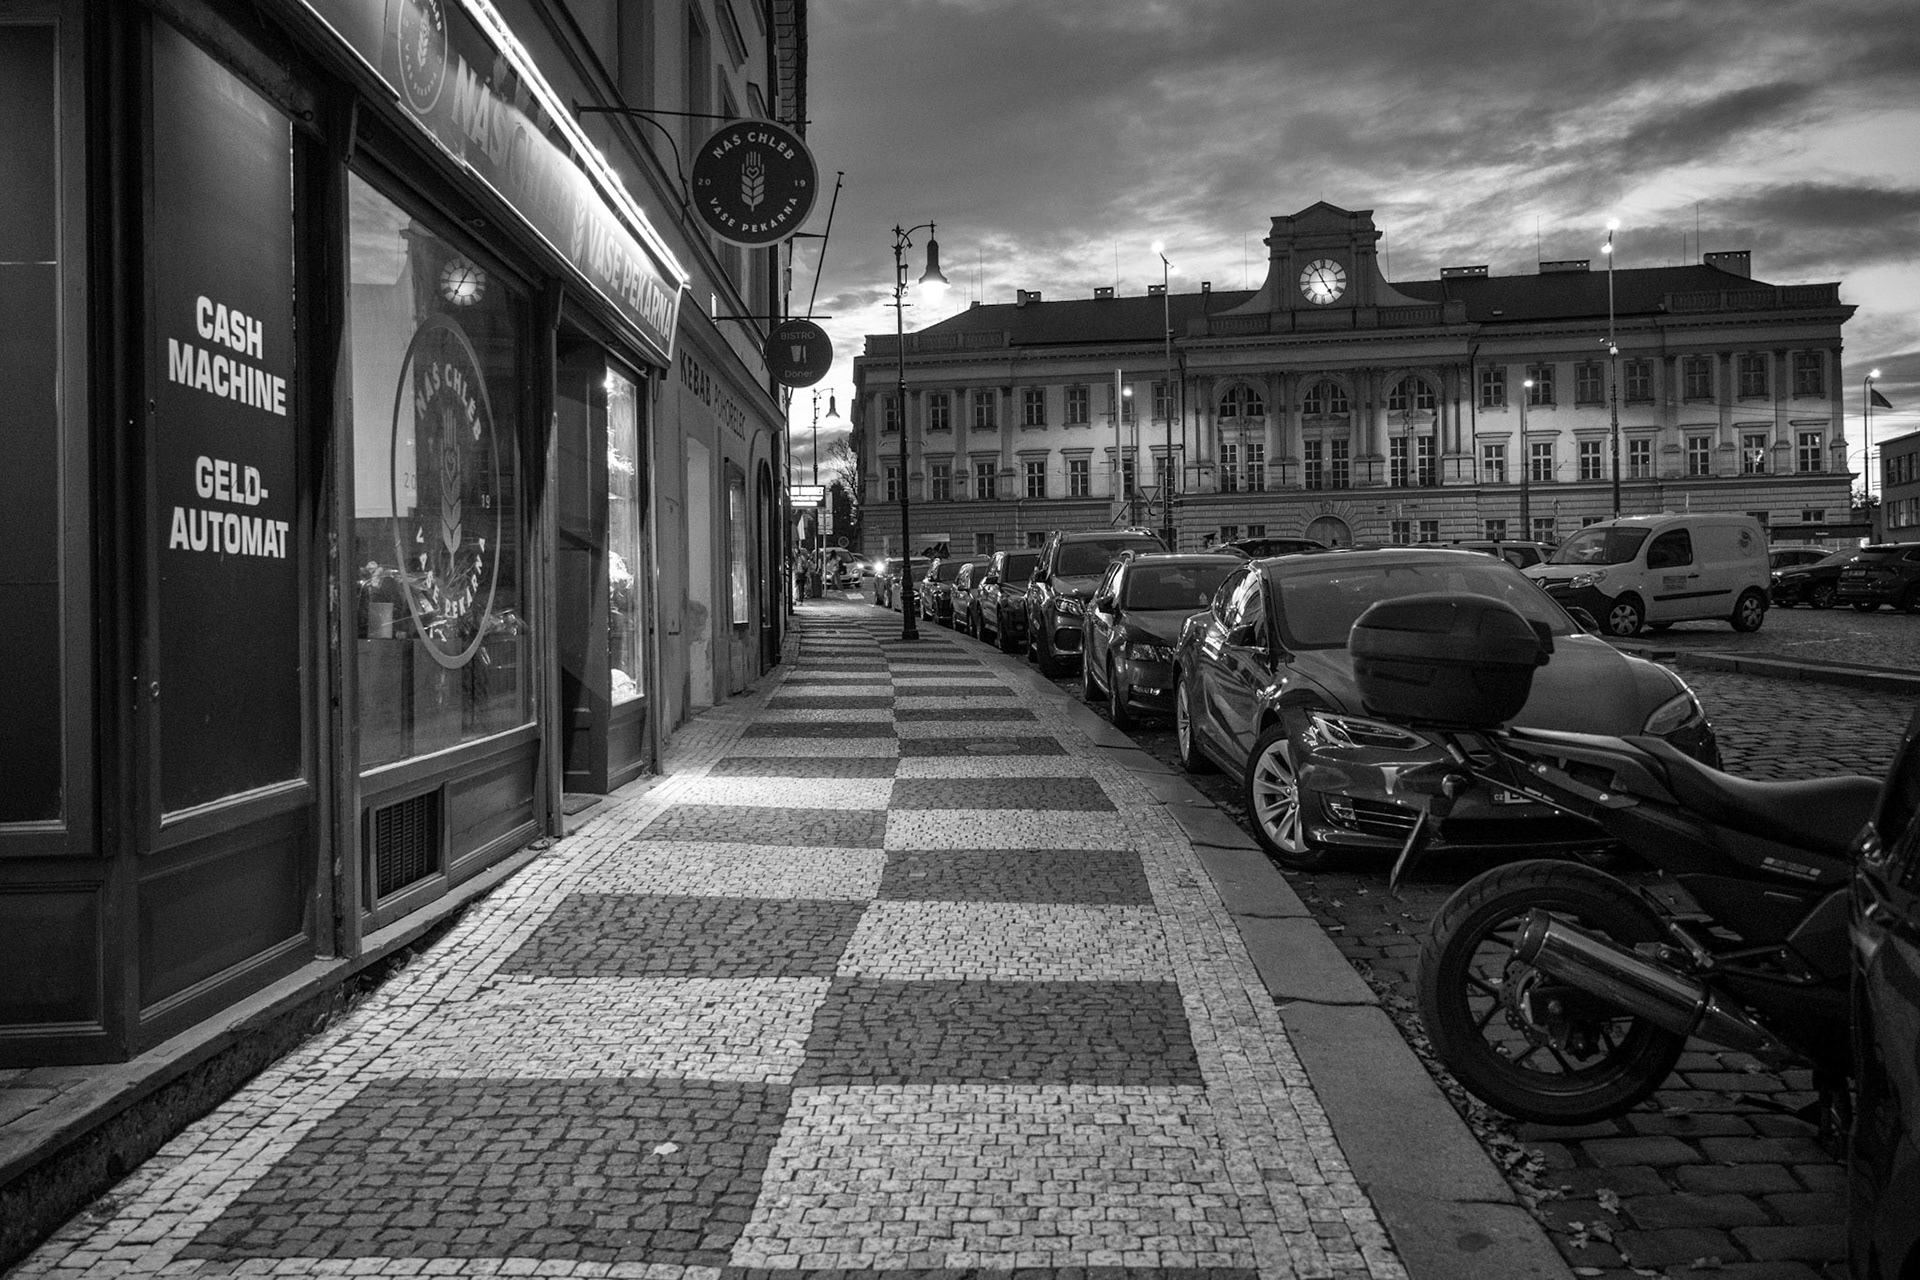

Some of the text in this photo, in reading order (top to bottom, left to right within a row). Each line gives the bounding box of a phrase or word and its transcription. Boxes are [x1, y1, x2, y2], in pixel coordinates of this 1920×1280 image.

[698, 178, 711, 186] 20
[794, 179, 806, 187] 19
[196, 295, 263, 360] CASH
[780, 331, 816, 341] BISTRO
[168, 337, 287, 416] MACHINE
[680, 346, 711, 407] KEBAB
[195, 455, 269, 506] GELD-
[168, 506, 290, 559] AUTOMAT
